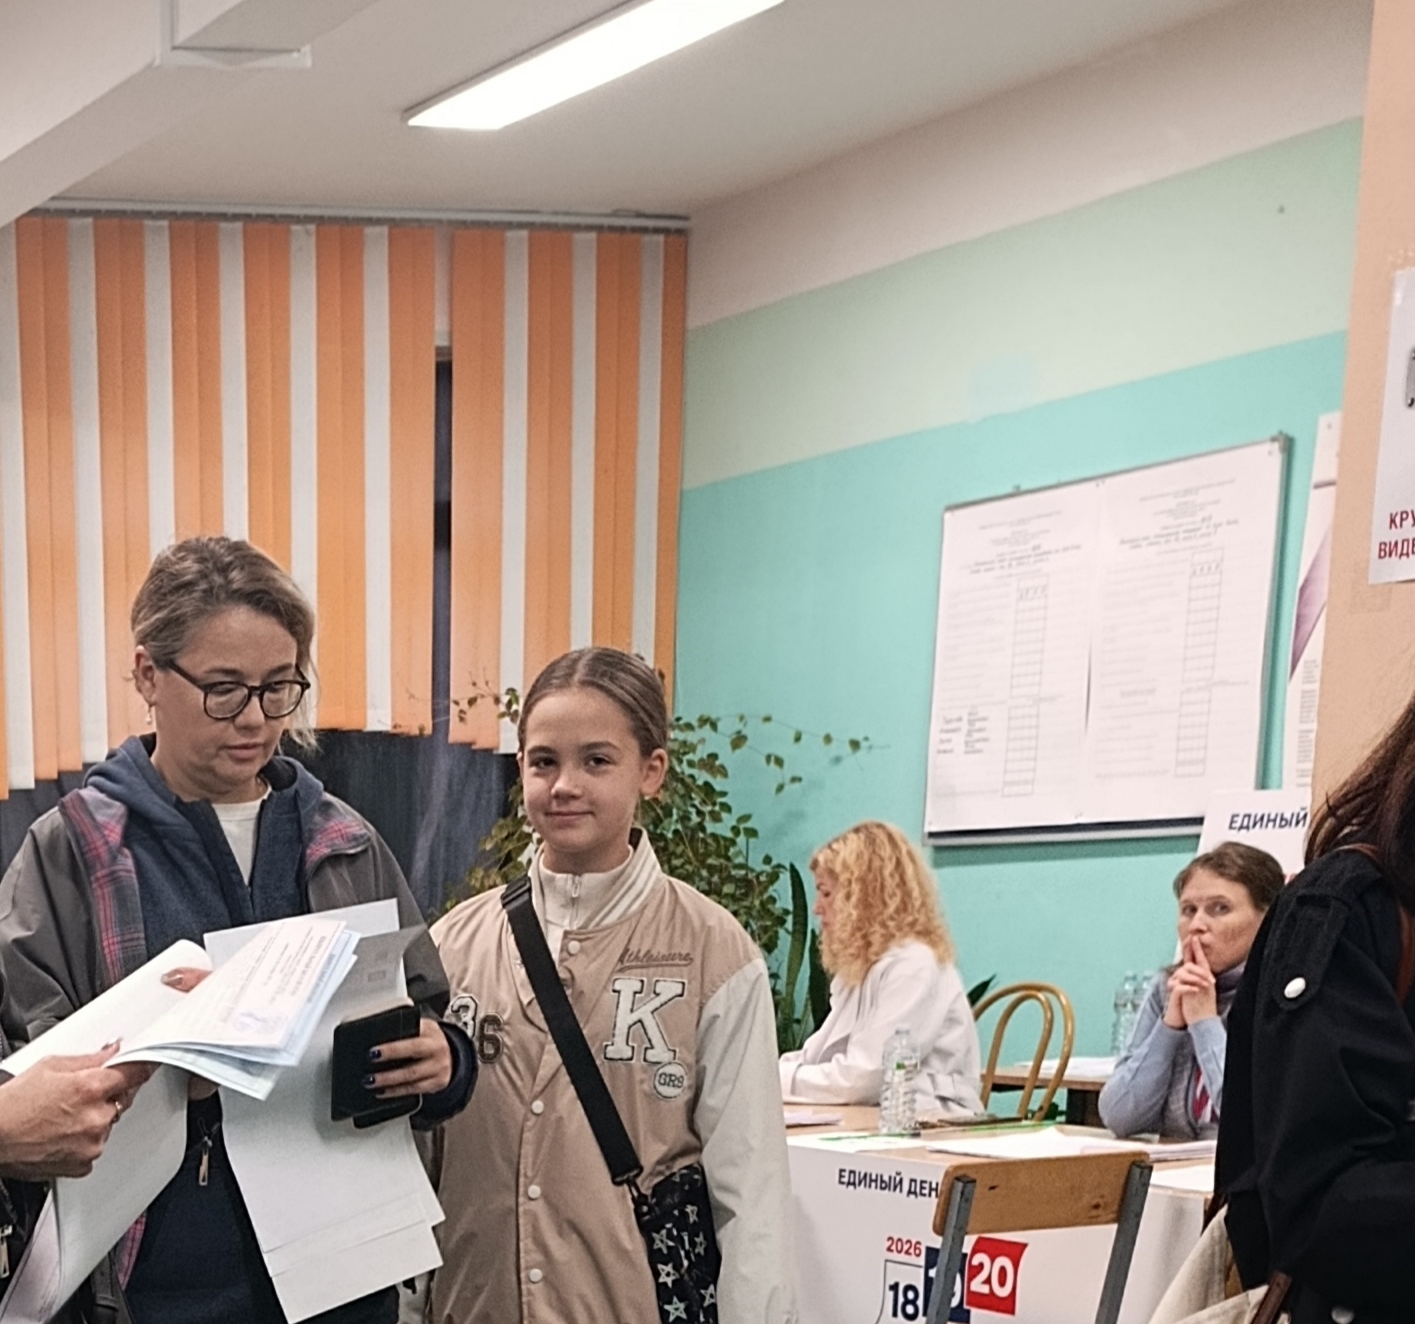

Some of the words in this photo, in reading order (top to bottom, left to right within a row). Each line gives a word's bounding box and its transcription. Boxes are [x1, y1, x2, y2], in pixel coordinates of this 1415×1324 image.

[1228, 806, 1308, 832] ЕДИНЫЙ
[603, 976, 686, 1064] K
[838, 1168, 904, 1194] ЕДИНЫЙ
[906, 1178, 940, 1199] ДЕН
[886, 1236, 922, 1258] 2026
[888, 1281, 920, 1322] 18
[969, 1252, 1015, 1298] 20
